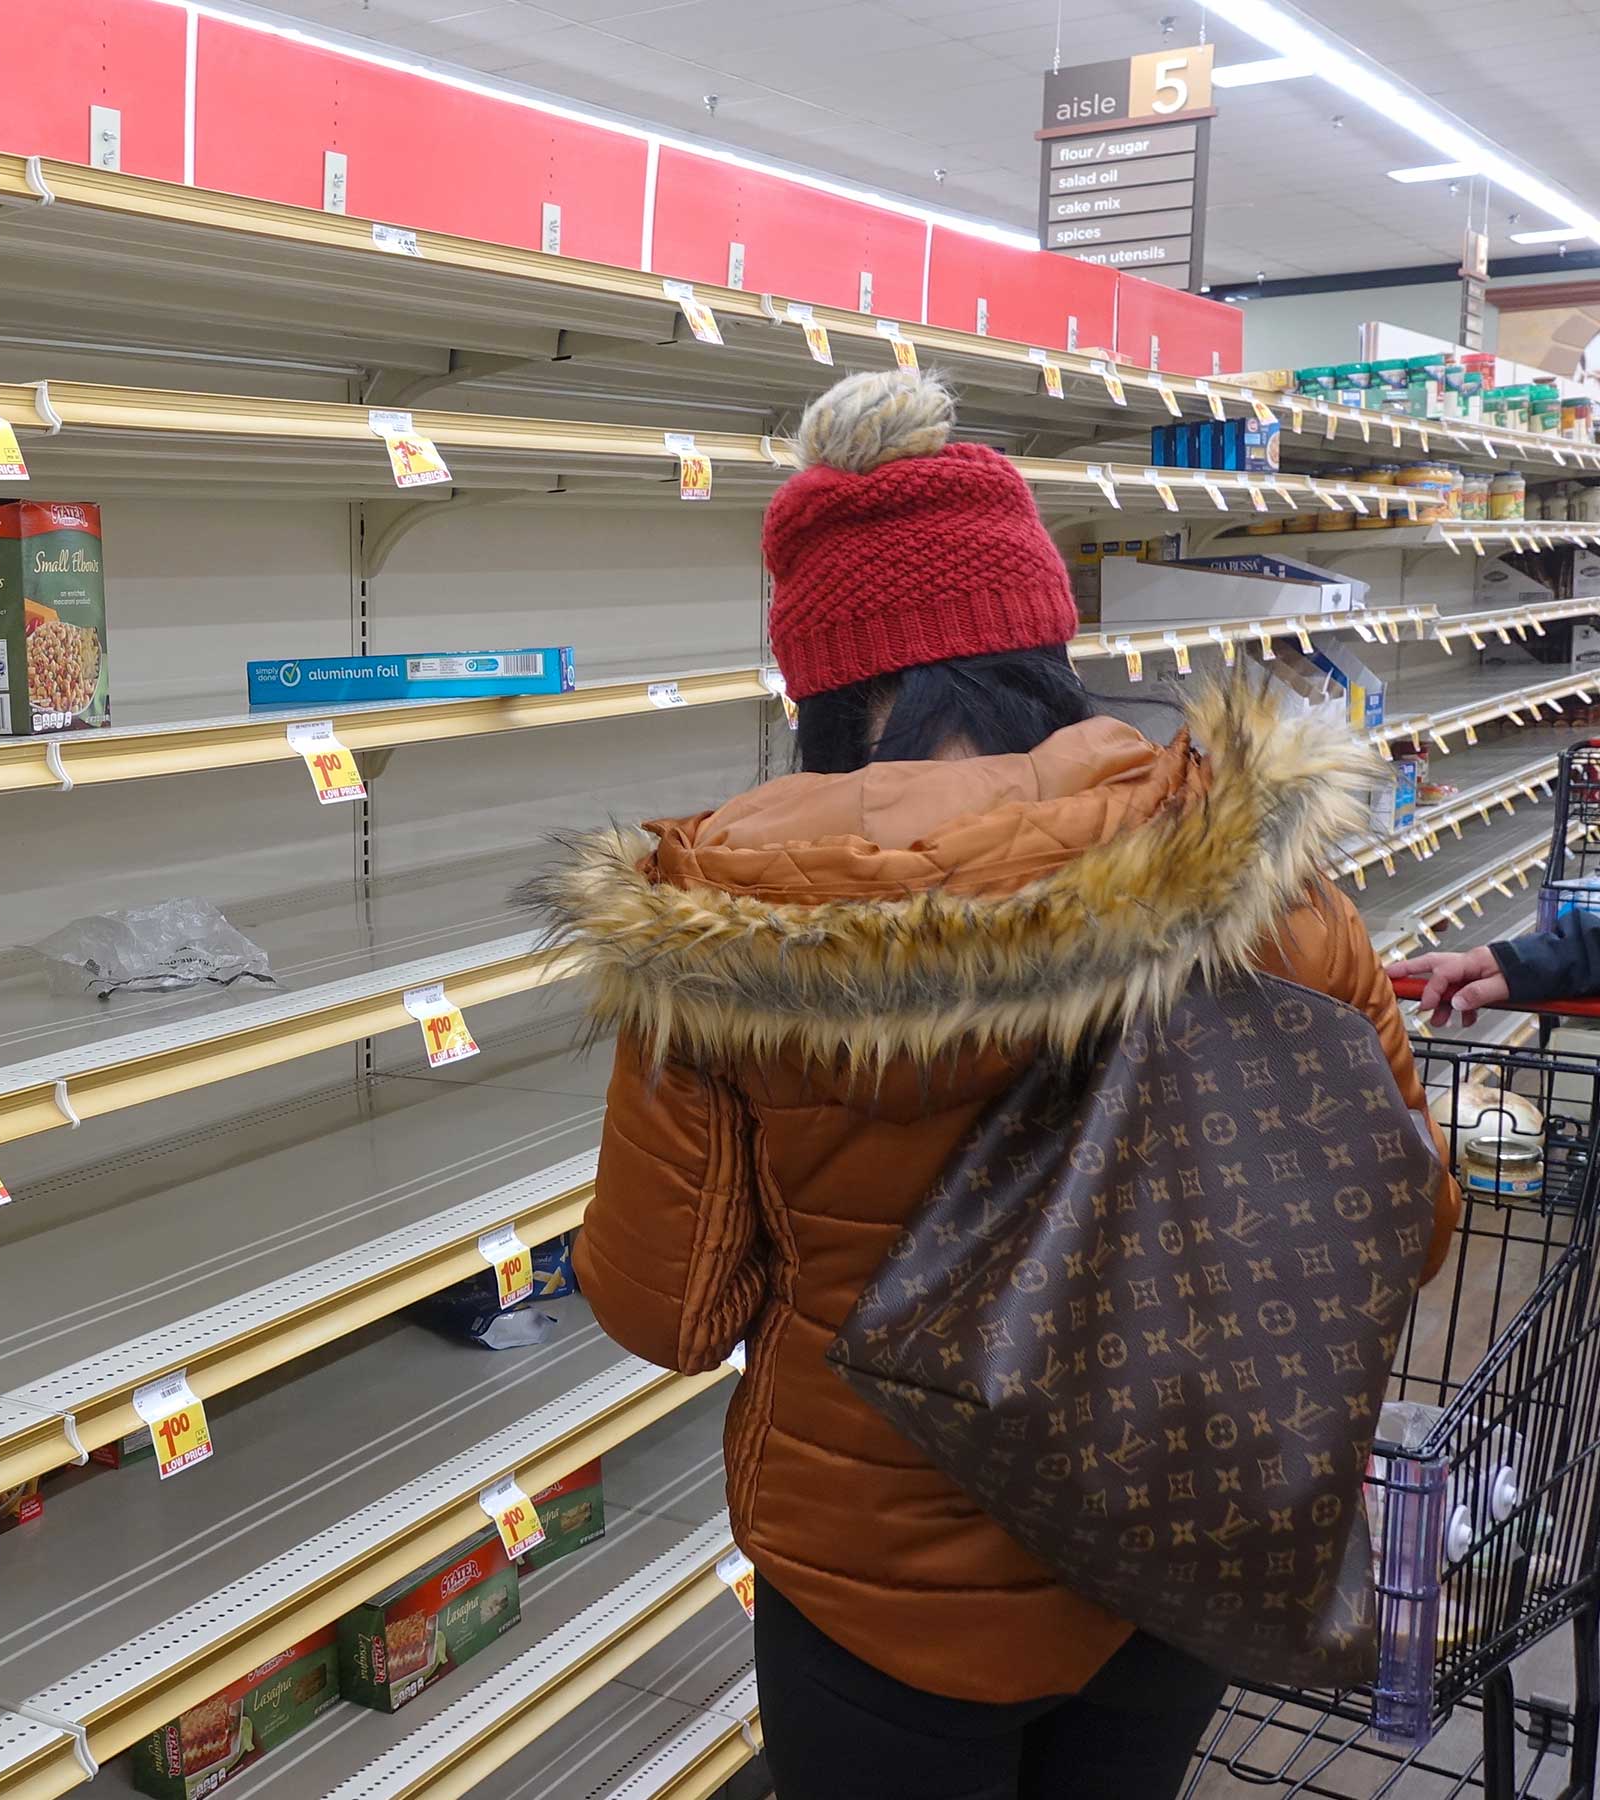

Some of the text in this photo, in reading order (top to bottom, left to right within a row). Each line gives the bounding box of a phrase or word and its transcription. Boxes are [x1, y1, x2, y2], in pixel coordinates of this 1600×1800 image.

[1056, 57, 1189, 121] aisle 5
[1059, 146, 1094, 162] flour
[1107, 140, 1150, 157] sugar
[1058, 169, 1118, 190] salad oil
[1057, 196, 1121, 216] cake mix
[1056, 225, 1102, 244] spices
[1110, 246, 1165, 263] utensils
[33, 548, 99, 573] Small Elbows
[255, 667, 279, 676] simply
[257, 673, 277, 682] done
[308, 664, 399, 681] aluminum foil
[165, 1444, 209, 1473] LOW PRICE
[441, 1559, 483, 1599] STATER
[446, 1596, 480, 1627] Lasagna
[371, 1635, 387, 1685] STATER
[253, 1676, 294, 1712] Lasagna
[166, 1725, 182, 1777] STATER
